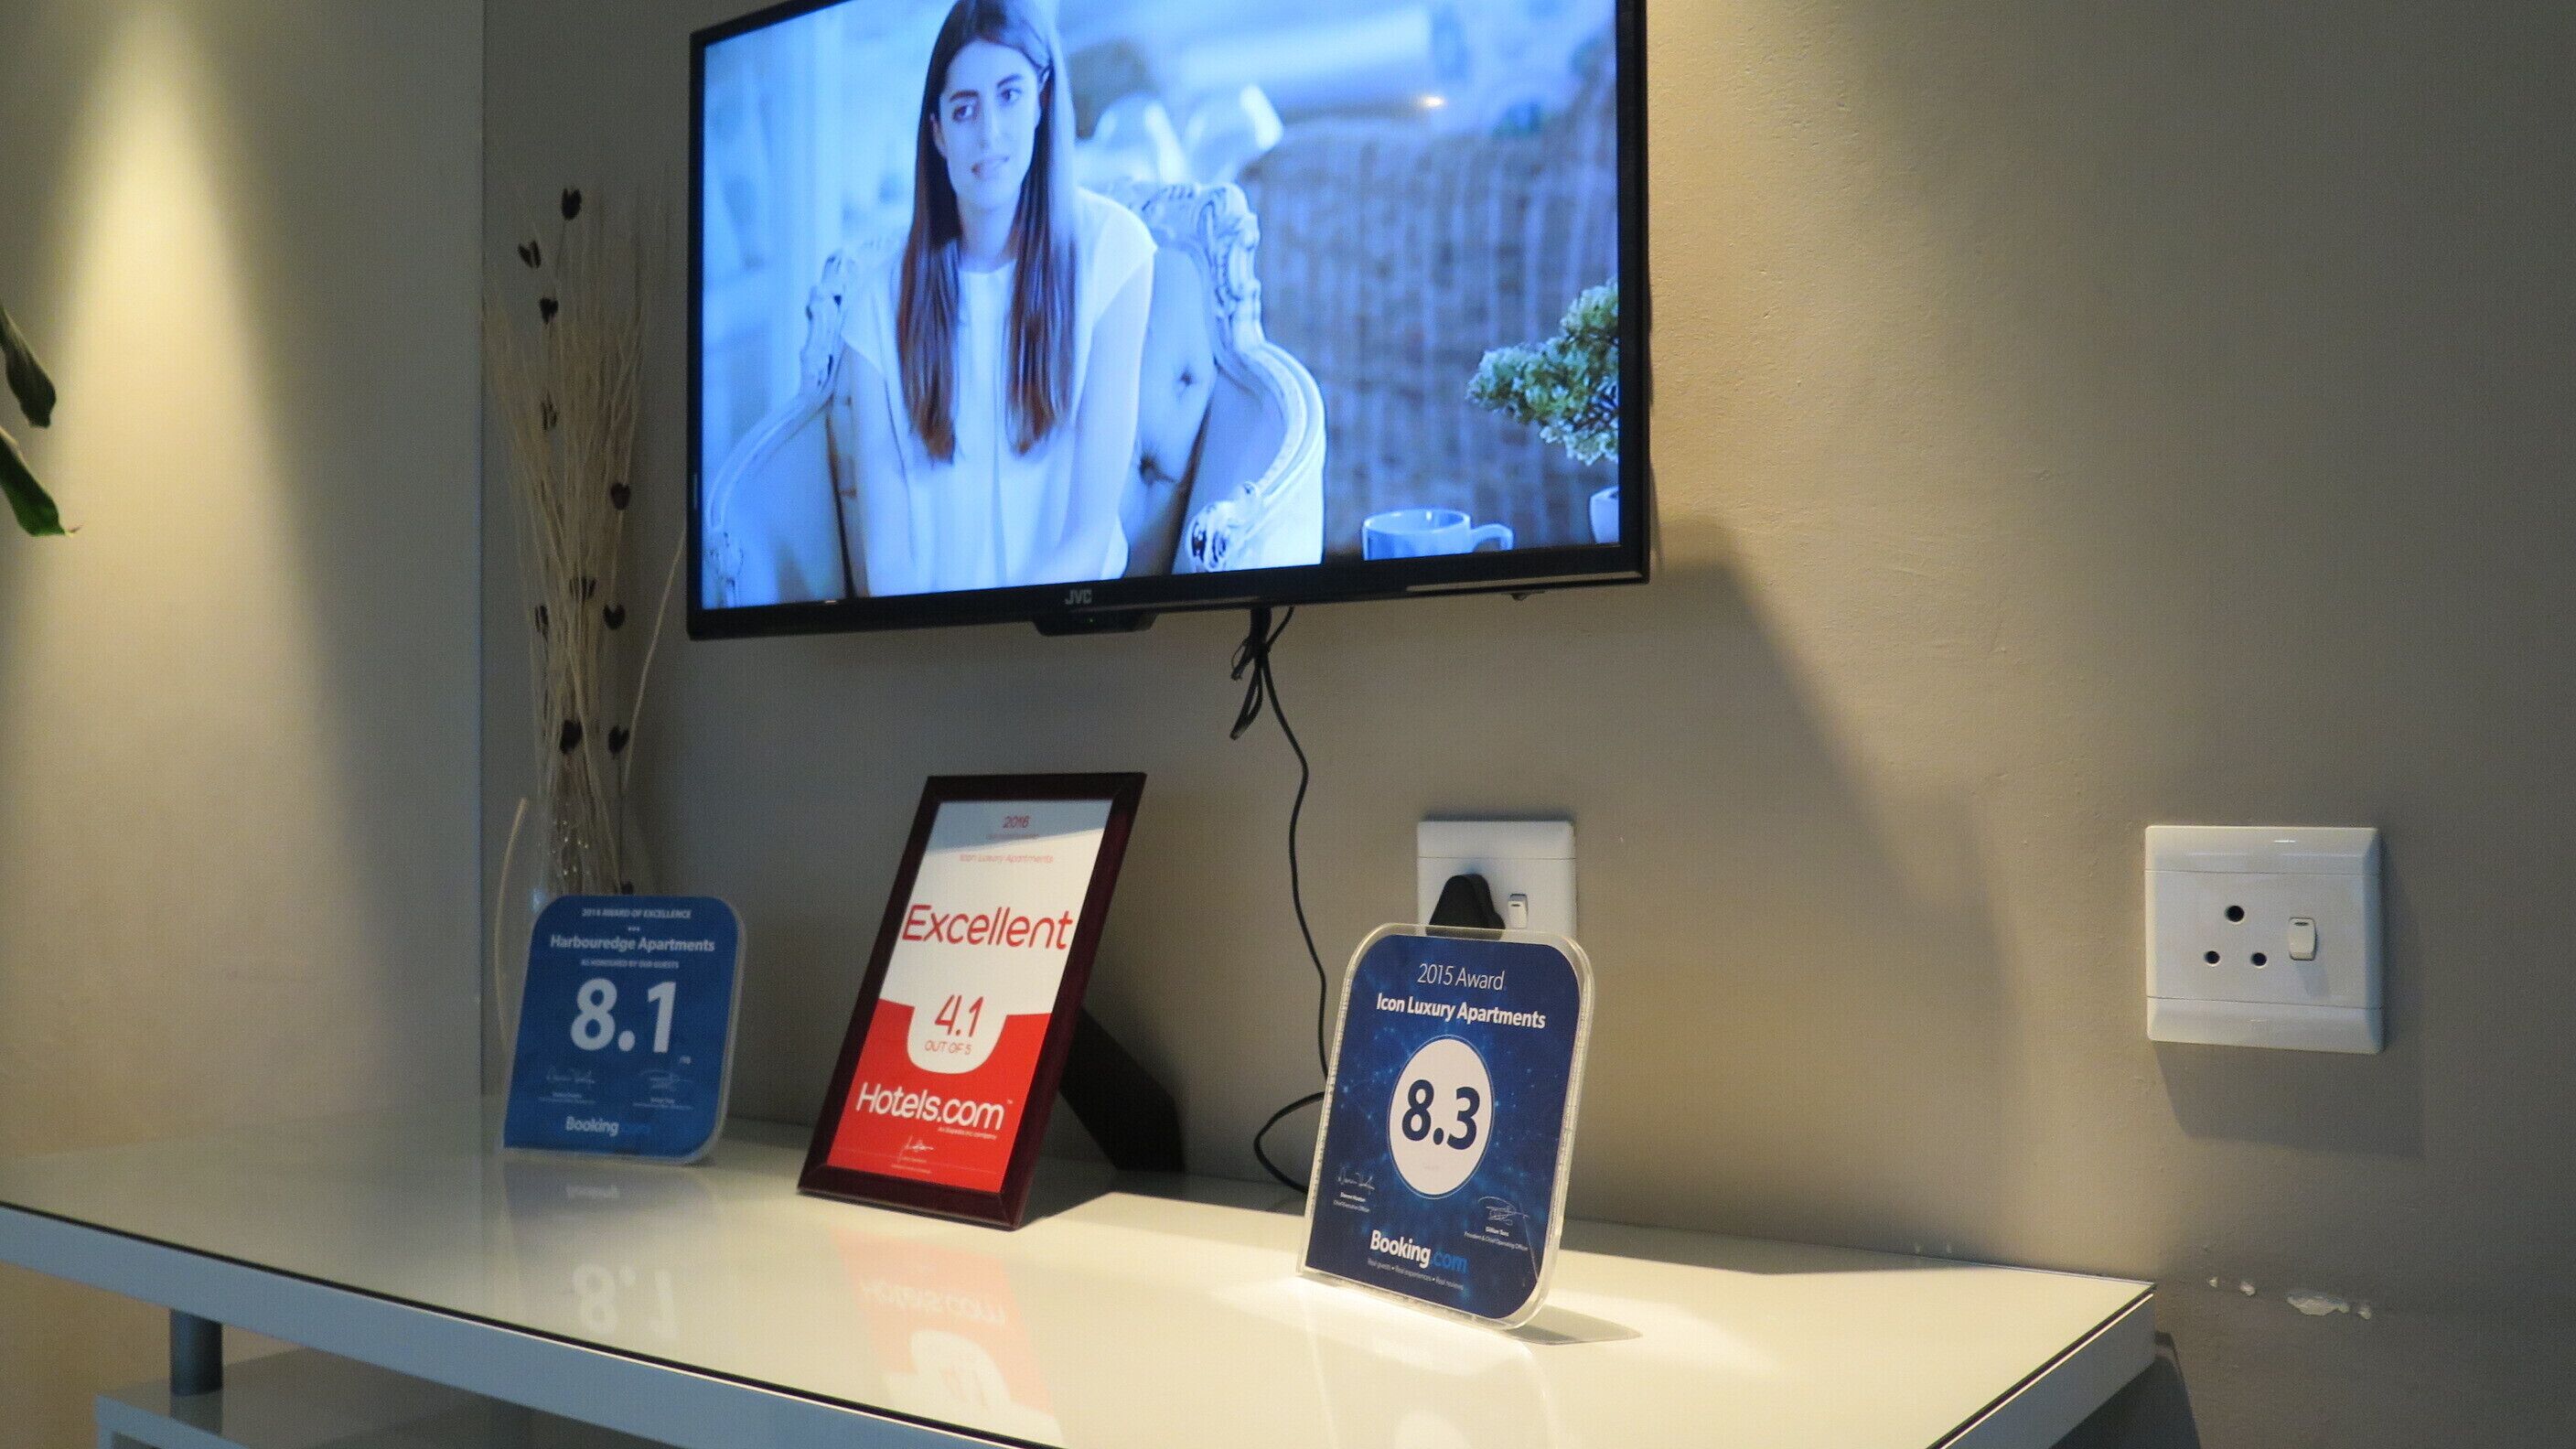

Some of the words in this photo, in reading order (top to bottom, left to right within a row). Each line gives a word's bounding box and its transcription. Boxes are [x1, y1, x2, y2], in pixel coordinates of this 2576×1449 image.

[1065, 588, 1092, 606] JVC
[549, 933, 636, 953] Harbouredge
[638, 936, 716, 953] Apartments
[901, 903, 1074, 951] Excellent
[1417, 962, 1454, 986] 2015
[1454, 967, 1506, 991] Award
[570, 977, 677, 1054] 8.1
[934, 993, 984, 1038] 4.1
[1376, 992, 1406, 1014] Icon
[1407, 994, 1456, 1023] Luxury
[1456, 1001, 1547, 1030] Apartments
[924, 1039, 947, 1053] OUT
[948, 1041, 964, 1054] OF
[964, 1043, 972, 1056] 5
[855, 1081, 1005, 1131] Hotels.com
[1401, 1079, 1481, 1152] 8.3
[564, 1115, 650, 1138] Booking
